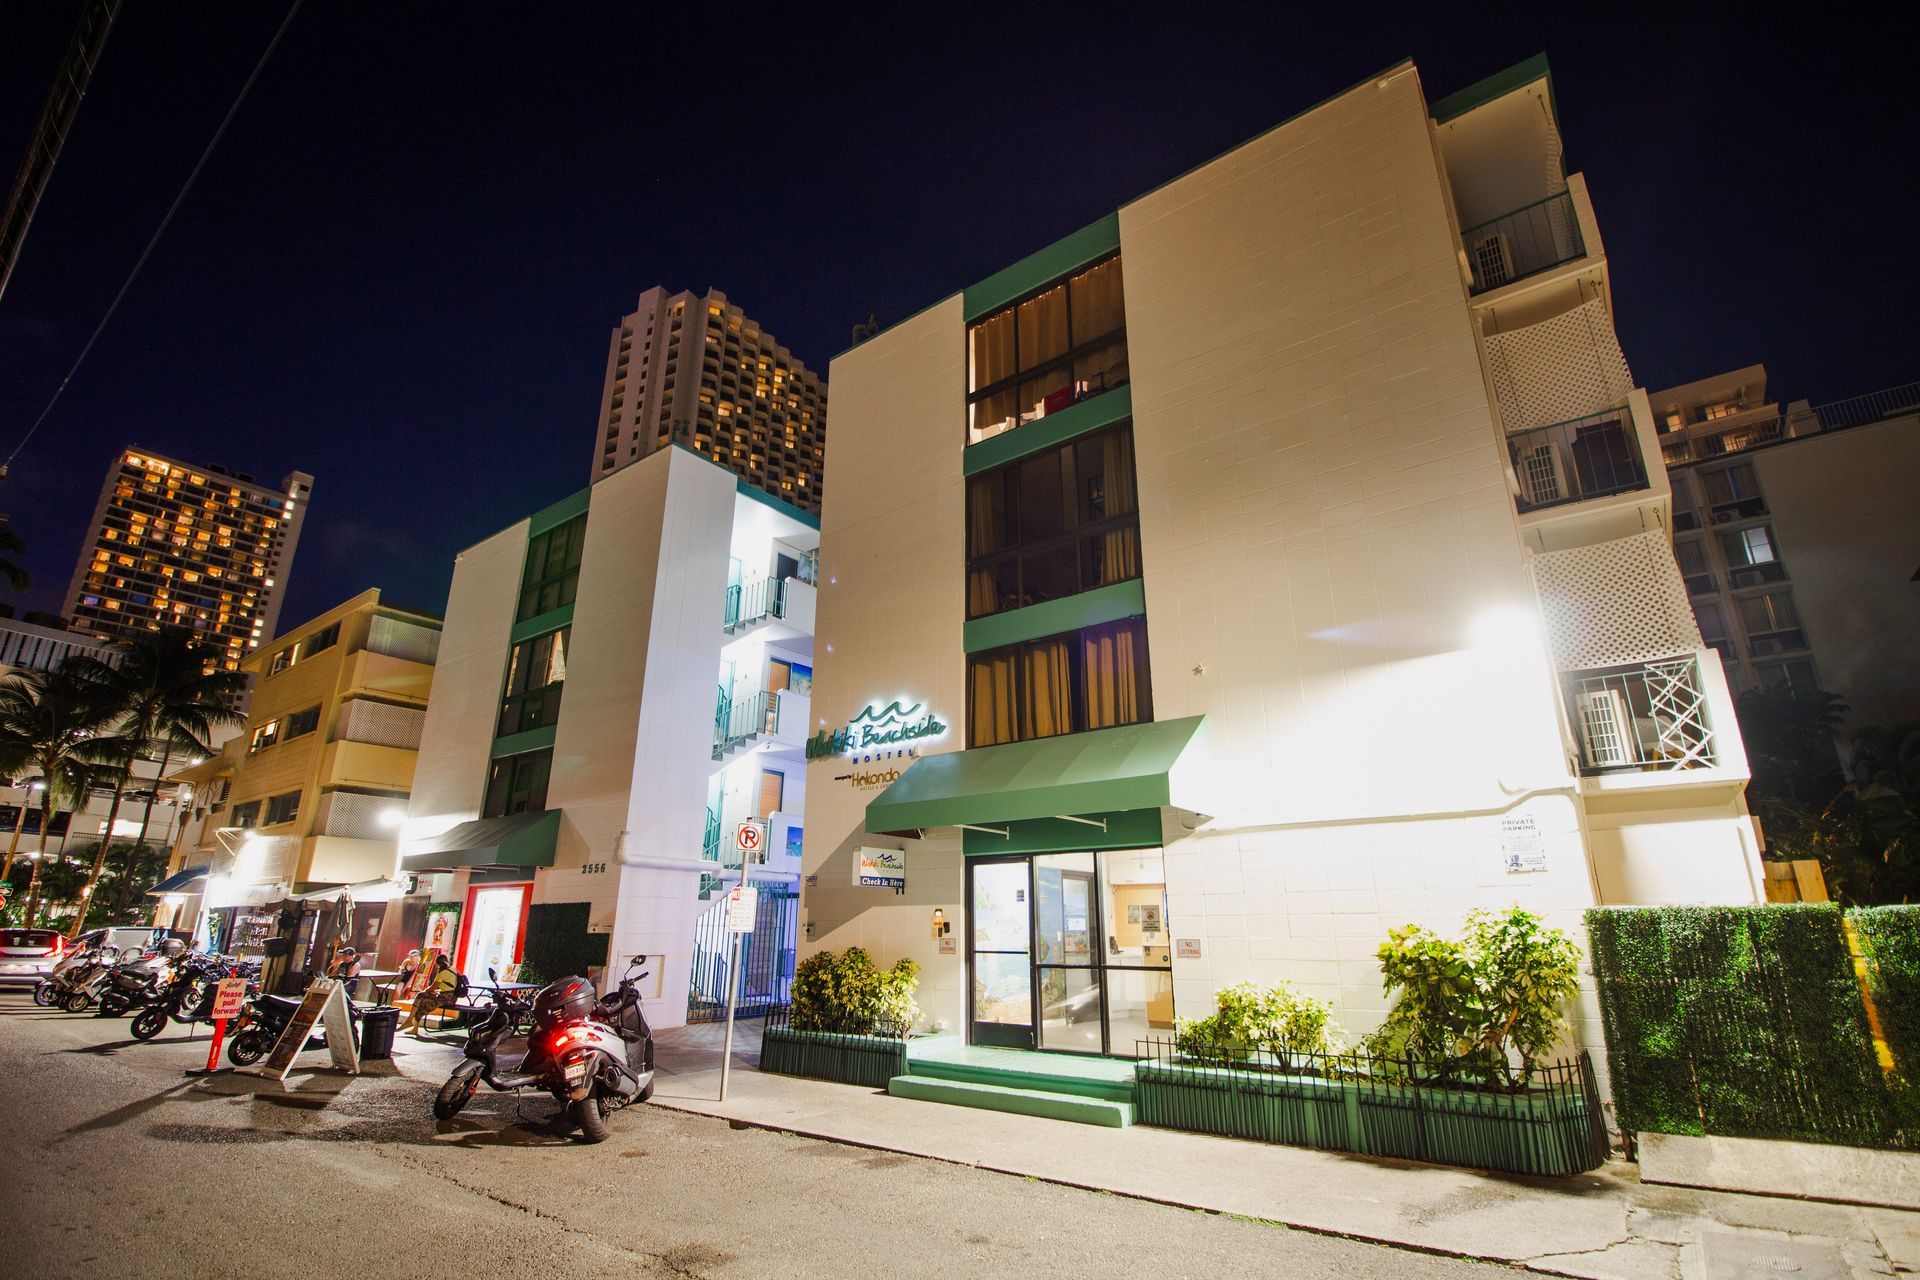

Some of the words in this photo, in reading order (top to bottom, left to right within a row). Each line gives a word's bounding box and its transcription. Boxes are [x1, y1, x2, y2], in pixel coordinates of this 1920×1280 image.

[860, 714, 947, 749] Beachside
[853, 749, 914, 764] HOSTEL
[581, 863, 607, 874] 2556
[862, 877, 881, 886] Check
[881, 878, 889, 886] In
[889, 879, 904, 888] Here
[222, 999, 236, 1007] pull
